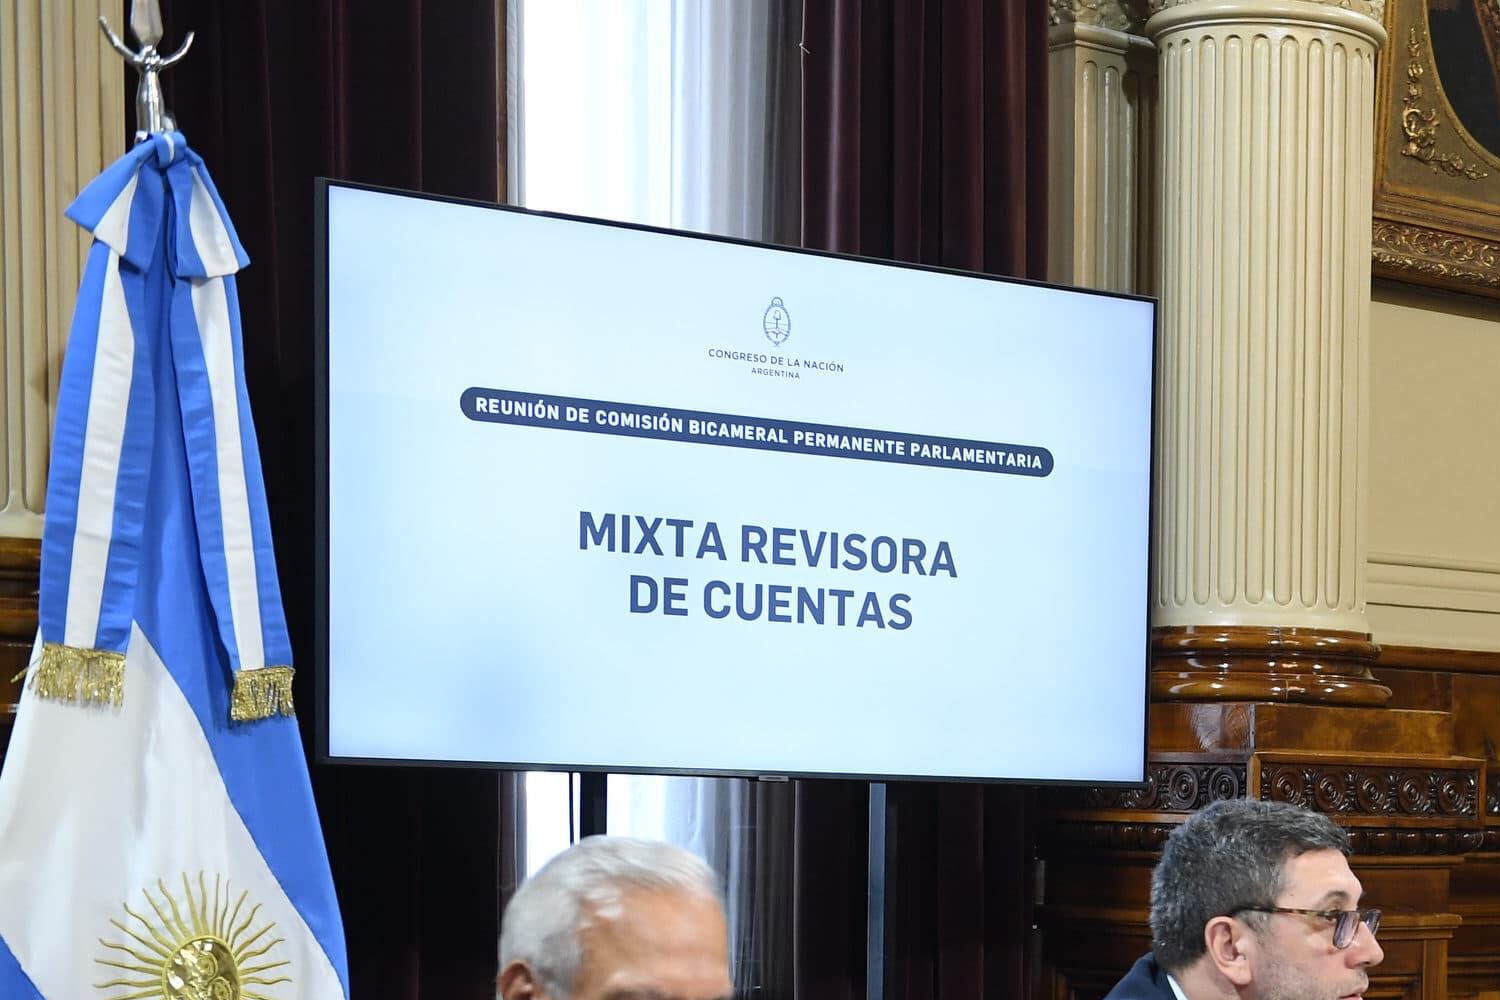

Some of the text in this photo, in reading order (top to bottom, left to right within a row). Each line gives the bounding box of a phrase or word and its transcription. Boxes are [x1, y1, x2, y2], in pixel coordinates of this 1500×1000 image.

[708, 348, 844, 372] CONGRESO DE LA NACIÓN
[751, 367, 800, 379] ARGENTINA
[475, 397, 1042, 469] REUNIÓN DE COMISIÓN BICAMERAL PERMANENTE PARLAMENTARIA
[579, 511, 958, 578] MIXTA REVISORA
[630, 574, 913, 631] DE CUENTAS
